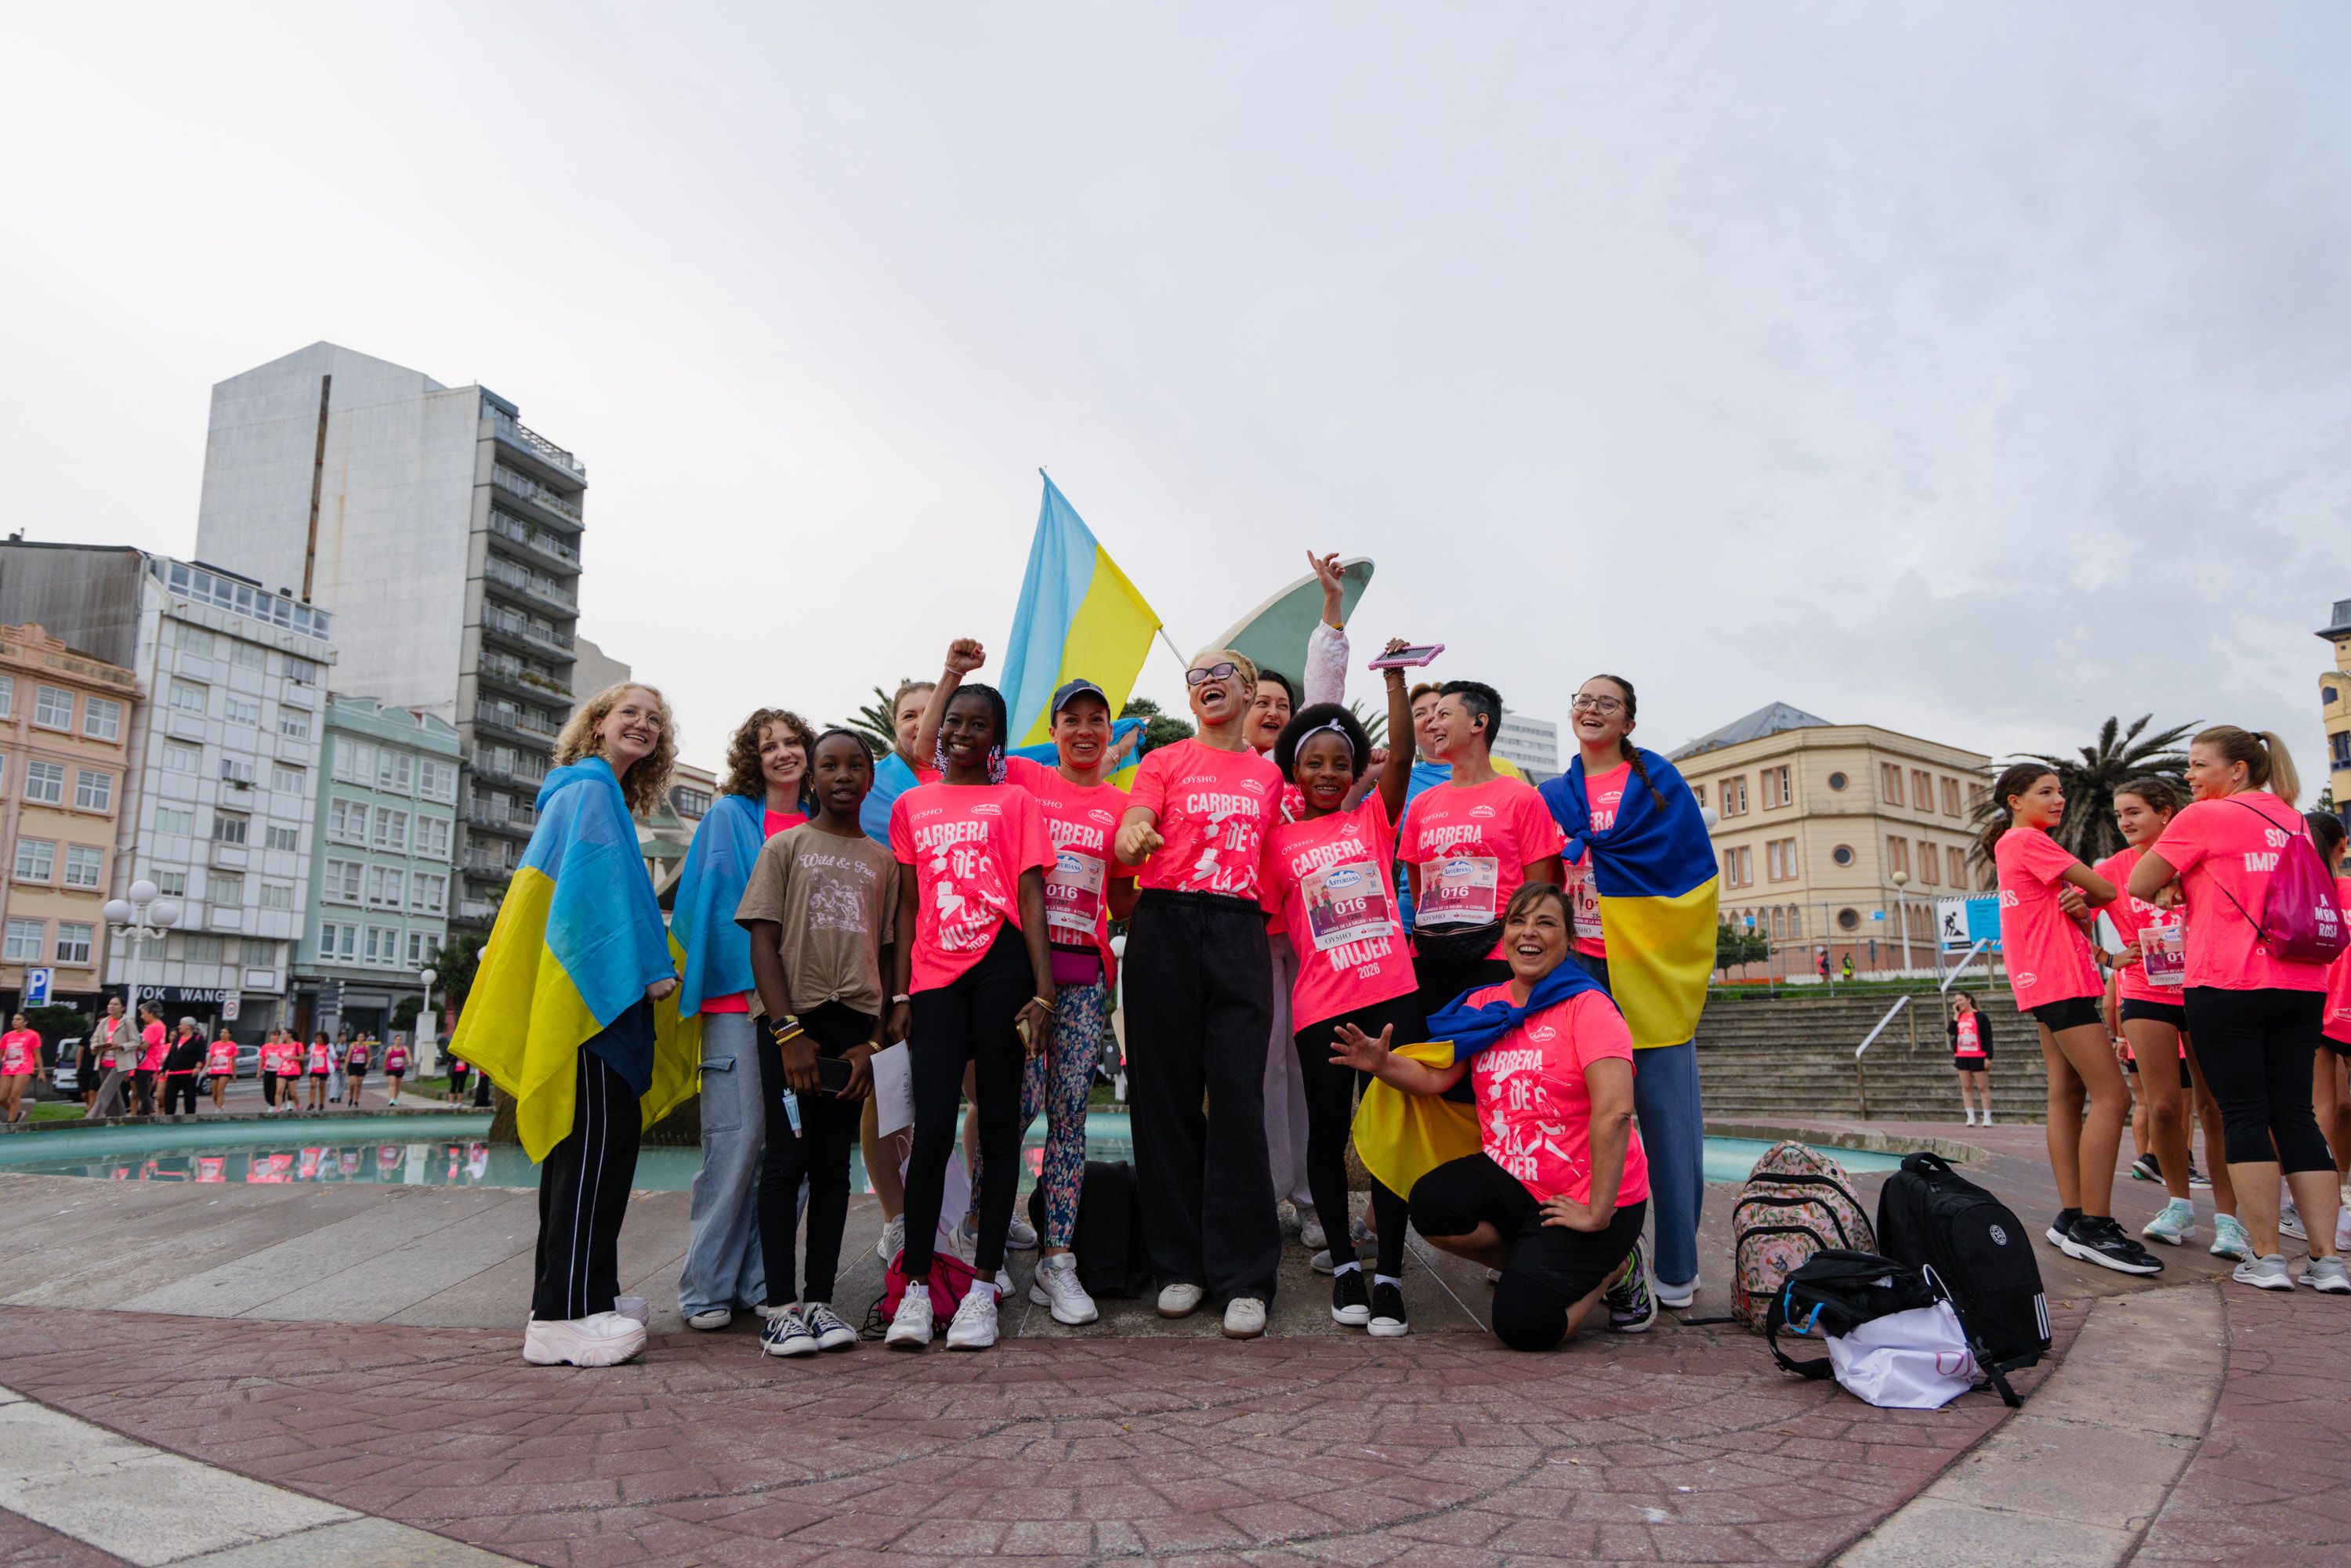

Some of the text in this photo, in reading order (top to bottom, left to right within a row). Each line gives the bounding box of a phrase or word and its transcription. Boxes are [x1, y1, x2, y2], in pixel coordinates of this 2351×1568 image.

[1183, 776, 1216, 784] OYSHO
[910, 808, 943, 823] OYSHO
[1422, 811, 1448, 824] OYSHO
[1281, 839, 1313, 856] OYSHO
[799, 853, 877, 879] Wild & Free
[1328, 875, 1359, 887] ASTURIANA
[1046, 884, 1078, 899] 016
[1440, 886, 1469, 899] 016
[1335, 897, 1367, 915] 016
[2320, 894, 2329, 907] A
[1346, 912, 1362, 921] 1298
[1320, 925, 1340, 935] CARRERA
[1325, 932, 1352, 944] OYSHO
[1329, 936, 1392, 972] MUJER
[2167, 952, 2185, 962] 01
[1357, 962, 1380, 980] 2026
[29, 970, 47, 995] P
[179, 987, 226, 1003] WANG
